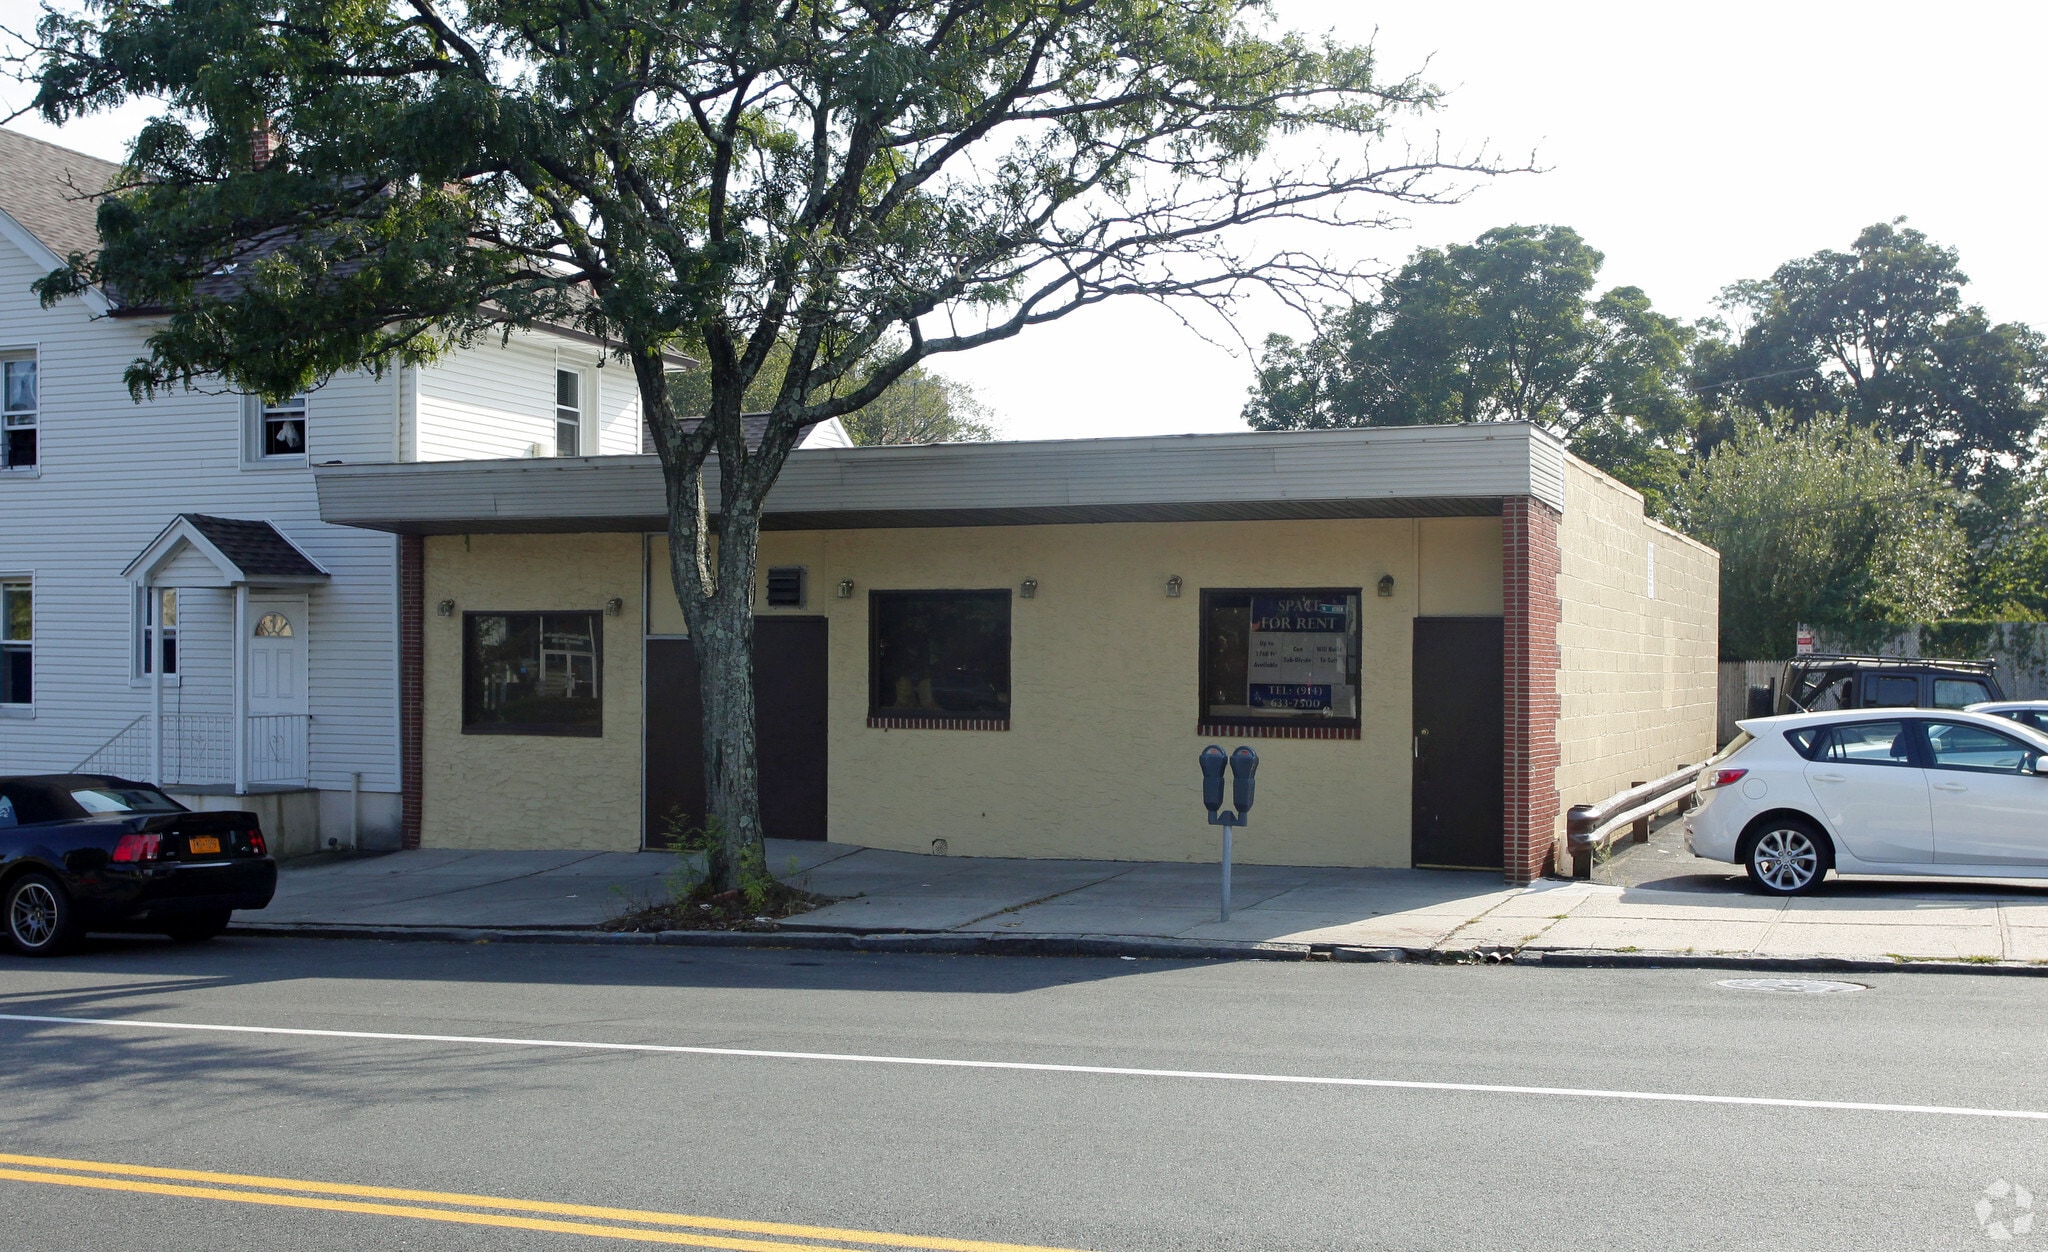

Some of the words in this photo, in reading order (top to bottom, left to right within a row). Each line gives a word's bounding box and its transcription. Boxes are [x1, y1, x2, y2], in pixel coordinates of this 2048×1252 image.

[1277, 599, 1322, 612] SPACE
[1261, 617, 1292, 629] FOR
[1296, 617, 1336, 629] RENT
[1268, 685, 1292, 695] TEL:
[1270, 698, 1321, 708] 633-7500
